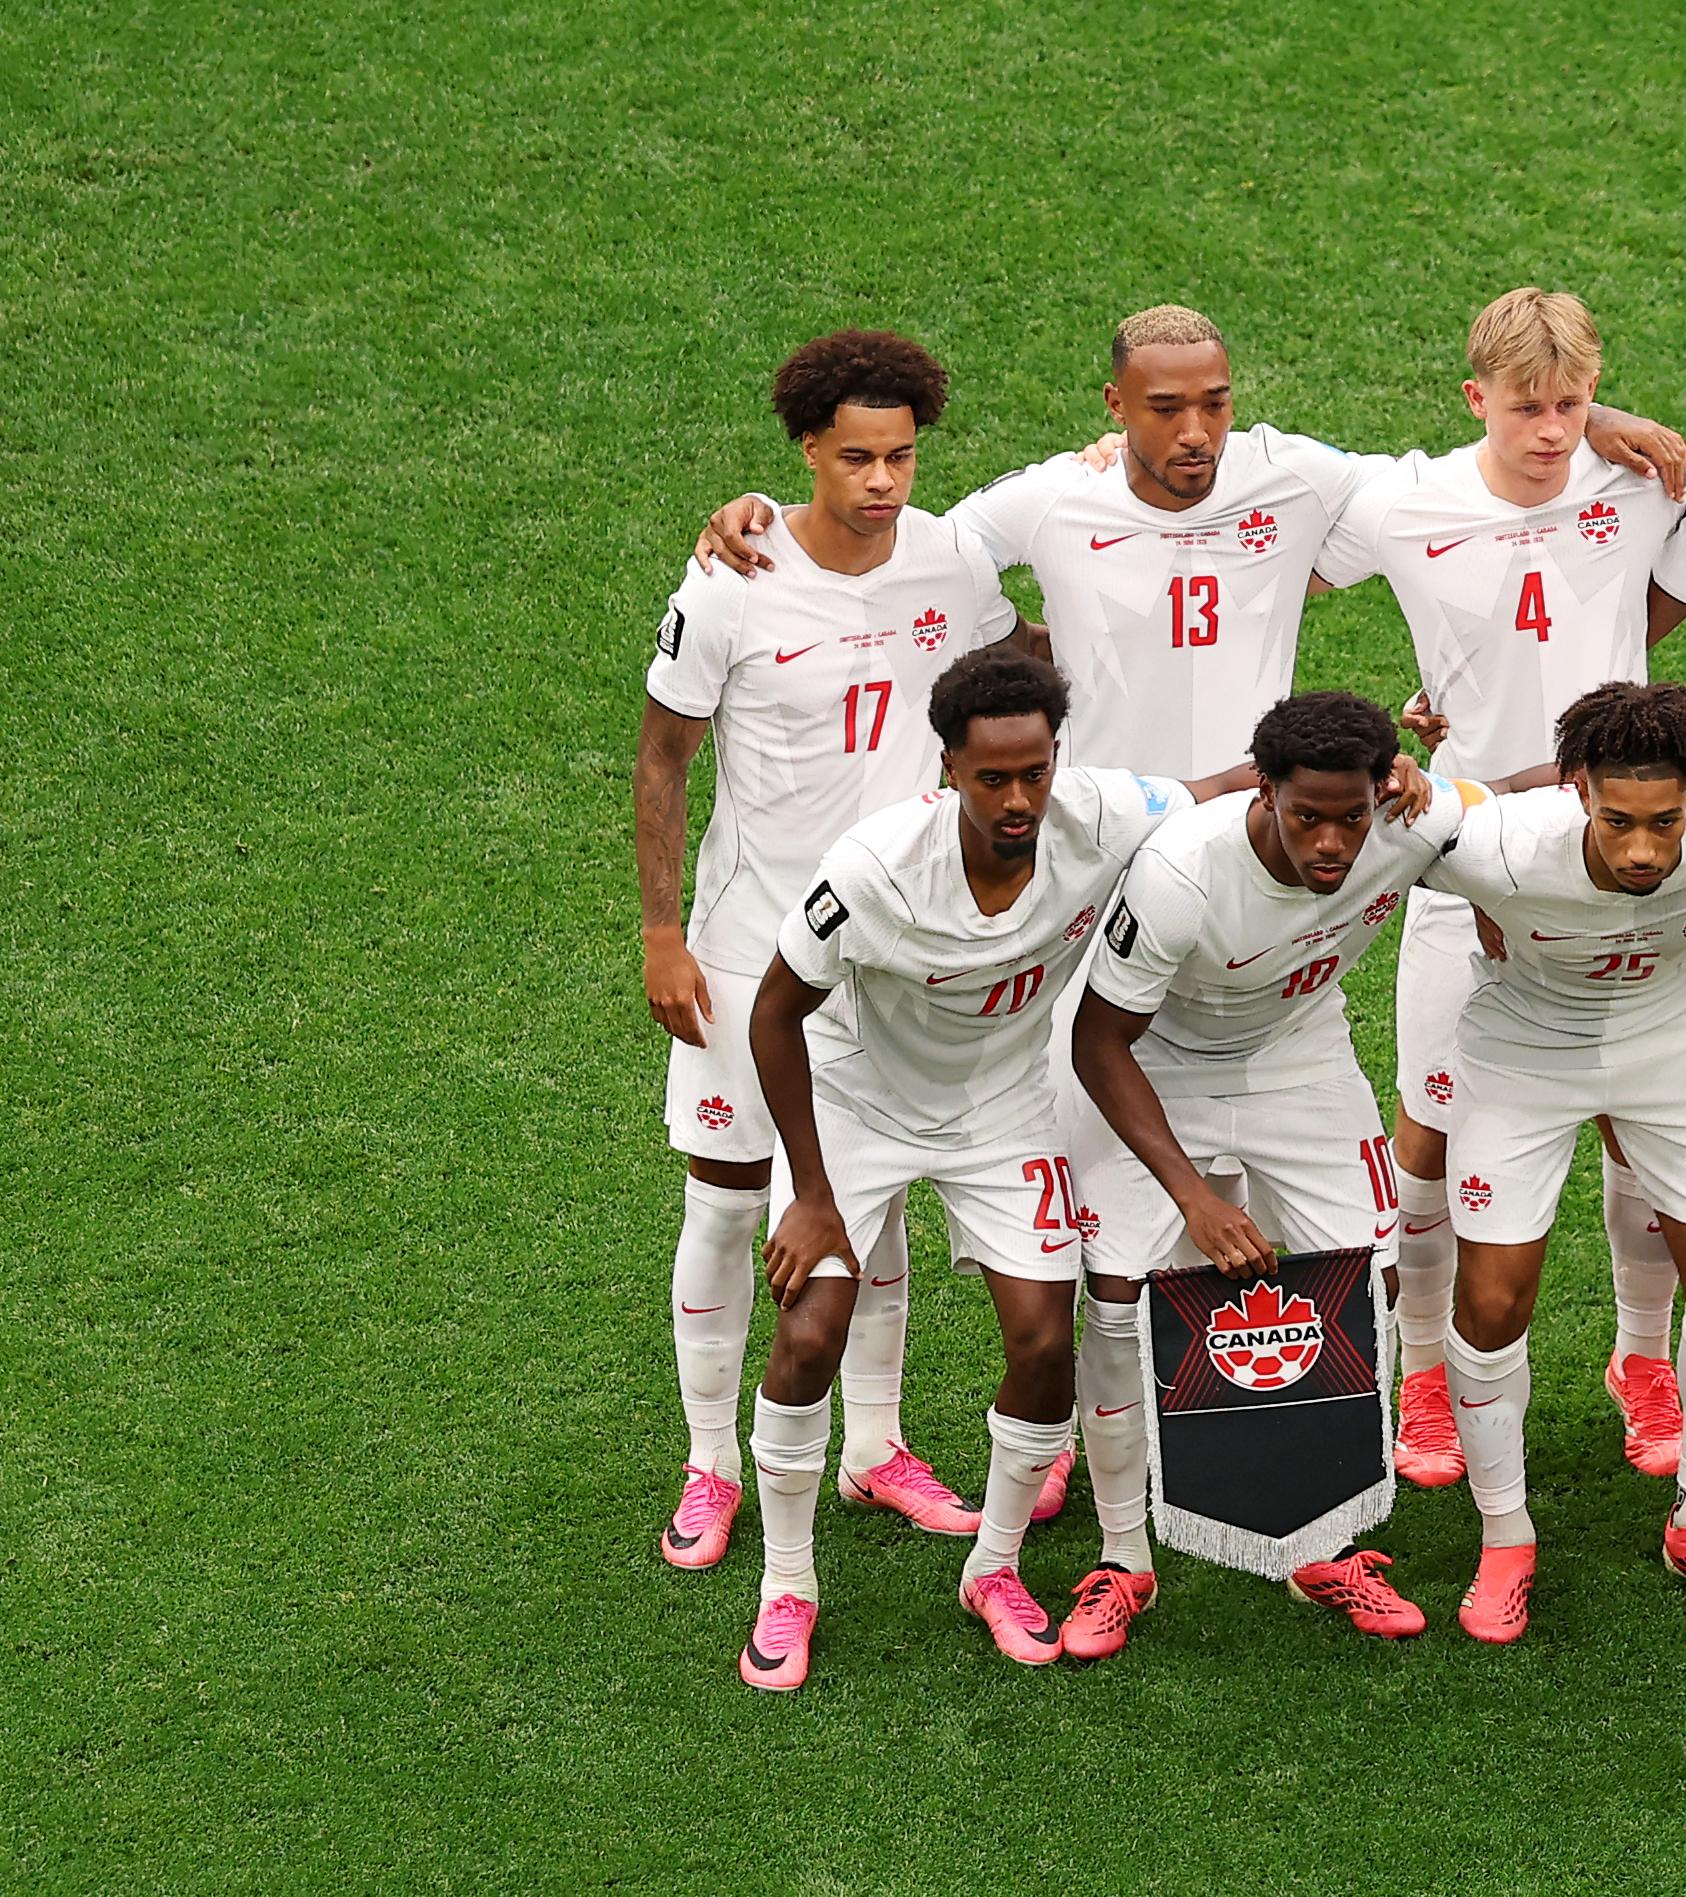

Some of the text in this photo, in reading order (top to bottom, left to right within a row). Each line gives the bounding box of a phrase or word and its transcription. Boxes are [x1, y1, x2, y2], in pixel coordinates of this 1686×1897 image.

[1237, 525, 1278, 538] CANADA
[1577, 517, 1620, 529] CANADA
[1168, 575, 1219, 648] 13
[1515, 571, 1552, 642] 4
[911, 624, 947, 636] CANADA
[842, 680, 893, 754] 17
[1281, 955, 1340, 999] 10
[1585, 953, 1660, 981] 25
[696, 1106, 734, 1119] CANADA
[1360, 1135, 1399, 1212] 10
[1022, 1156, 1079, 1230] 20
[1459, 1188, 1493, 1198] CANADA
[1209, 1325, 1320, 1349] CANADA
